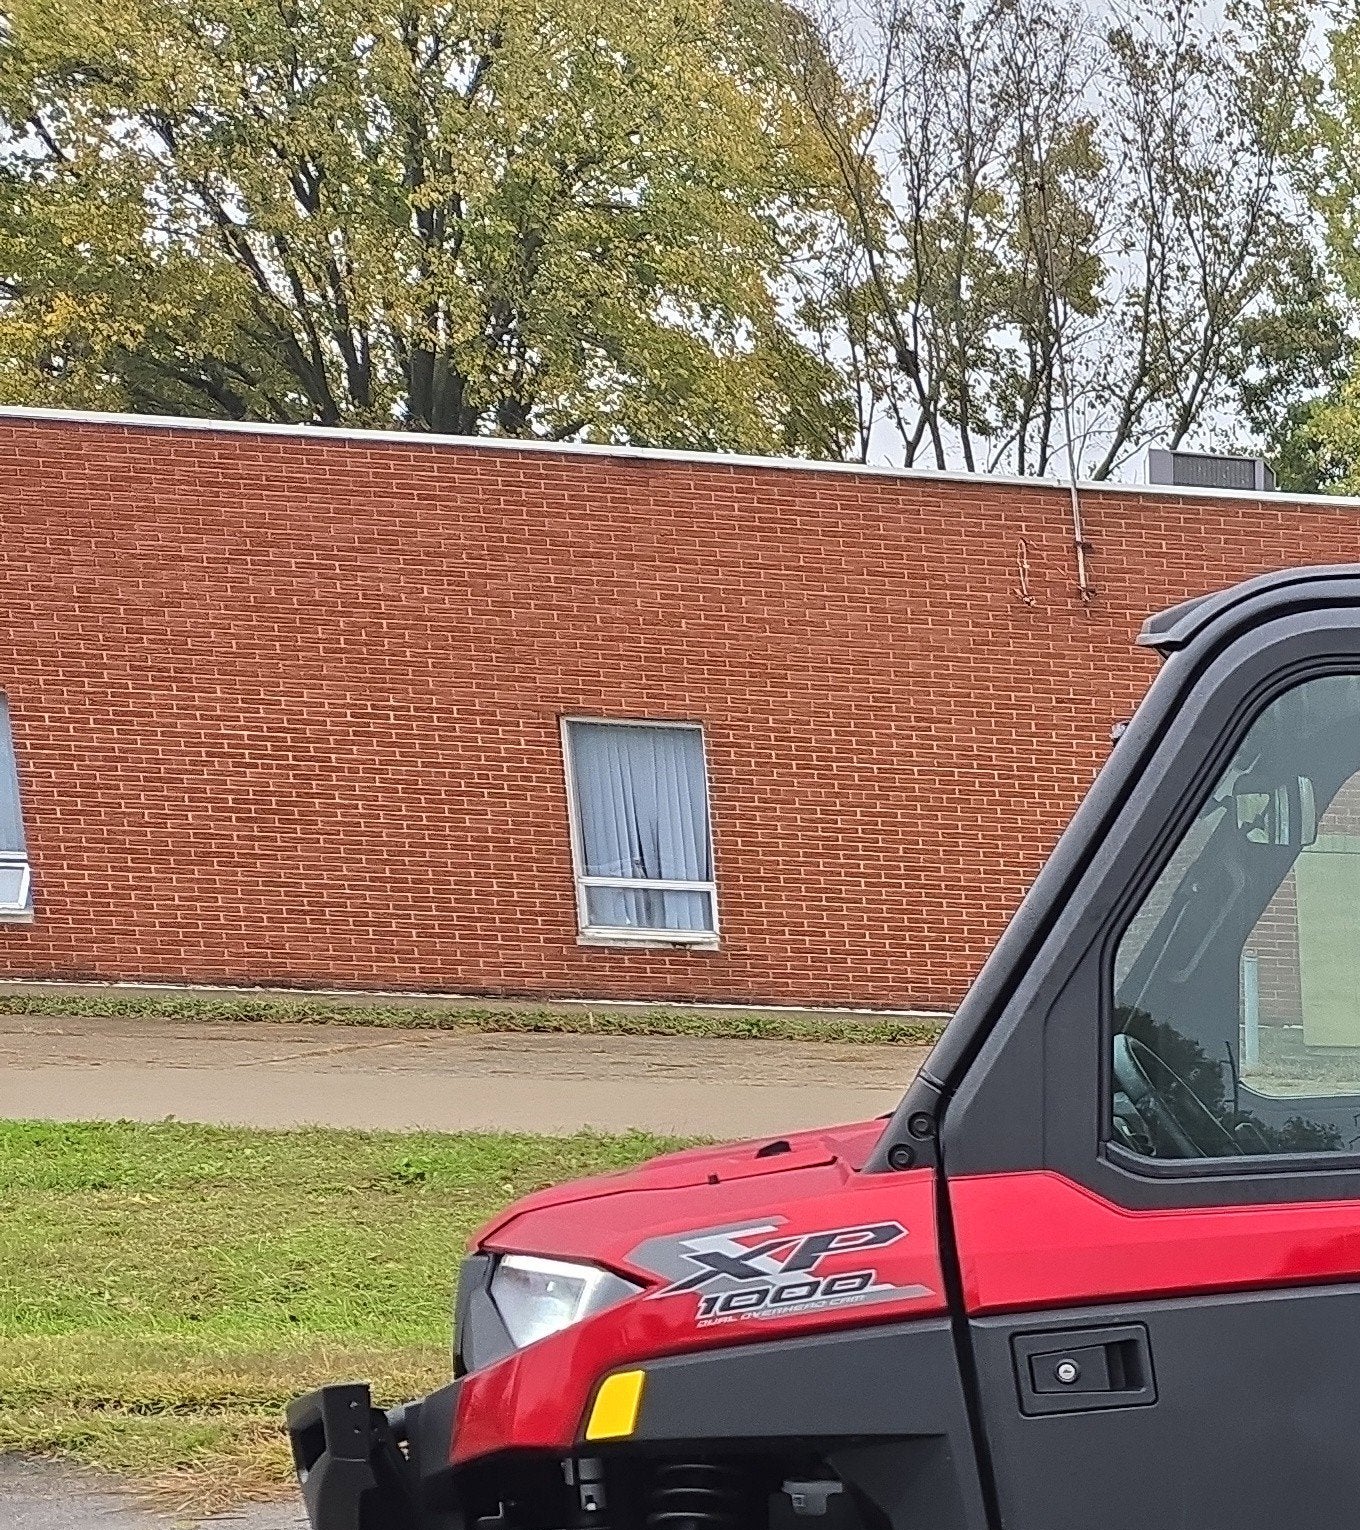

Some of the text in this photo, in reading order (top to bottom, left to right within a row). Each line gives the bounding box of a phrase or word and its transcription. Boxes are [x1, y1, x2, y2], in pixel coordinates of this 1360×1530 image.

[643, 1221, 910, 1301] XP
[695, 1268, 877, 1320] 1000
[696, 1315, 738, 1329] DUAL
